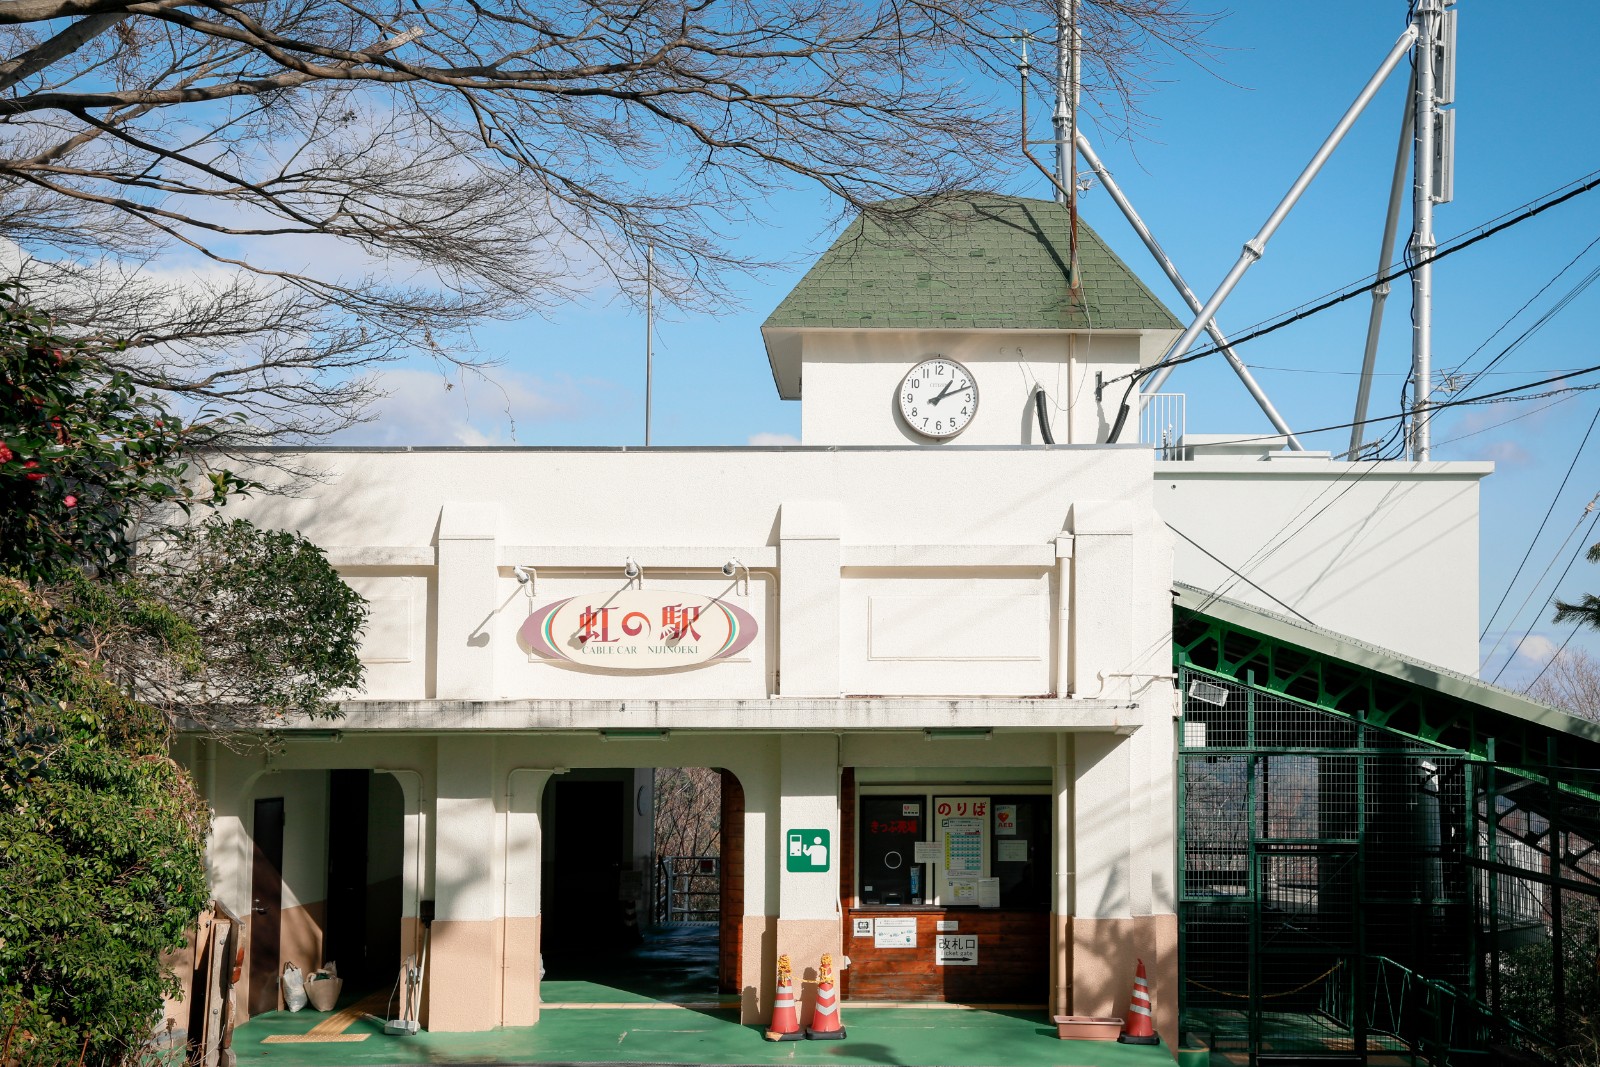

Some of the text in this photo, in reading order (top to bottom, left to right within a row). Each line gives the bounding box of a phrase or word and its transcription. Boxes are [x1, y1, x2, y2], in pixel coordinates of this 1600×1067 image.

[922, 368, 929, 379] 11
[935, 365, 944, 376] 12
[911, 378, 920, 389] 10
[960, 379, 967, 389] 2
[906, 393, 914, 403] 9
[964, 393, 972, 403] 3
[911, 406, 918, 417] 8
[960, 406, 968, 416] 4
[922, 417, 929, 428] 7
[935, 420, 942, 431] 6
[949, 417, 956, 428] 5
[578, 603, 702, 643] 虹の駅
[581, 645, 699, 655] CABLE CAR NIJINOEKI
[937, 802, 987, 817] のりば
[938, 937, 976, 951] 改札口
